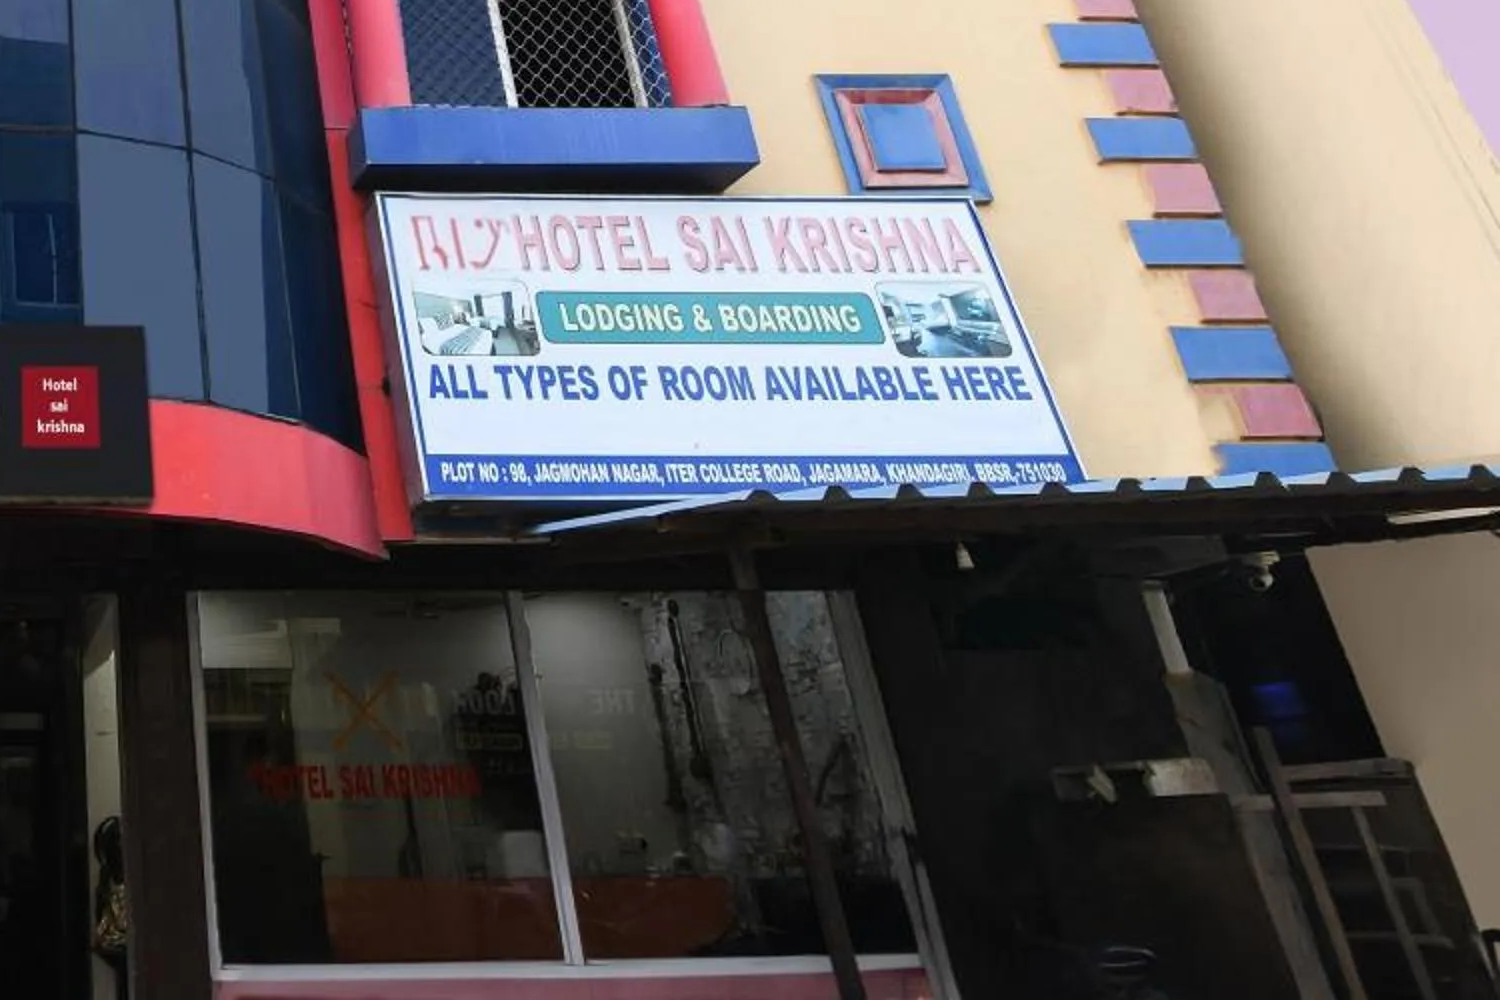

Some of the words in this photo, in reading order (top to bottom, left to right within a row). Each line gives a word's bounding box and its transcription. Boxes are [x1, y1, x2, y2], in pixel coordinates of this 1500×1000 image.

[512, 214, 671, 272] HOTEL
[676, 215, 759, 273] SAI
[763, 215, 983, 274] KRISHNA
[558, 302, 685, 333] LODGING
[692, 303, 713, 332] &
[719, 303, 862, 334] BOARDING
[42, 377, 78, 392] Hotel
[428, 363, 489, 400] ALL
[493, 364, 600, 401] TYPES
[607, 365, 649, 401] OF
[657, 365, 757, 401] ROOM
[764, 365, 940, 401] AVAILABLE
[941, 365, 1034, 401] HERE
[50, 399, 69, 413] sai
[36, 419, 85, 434] krishna
[440, 461, 475, 483] PLOT
[477, 462, 499, 483] NO
[533, 462, 610, 484] JAGMOHAN
[611, 463, 665, 488] NAGAR,
[665, 463, 699, 484] ITER
[699, 463, 762, 484] COLLEGE
[338, 764, 376, 798] SAI
